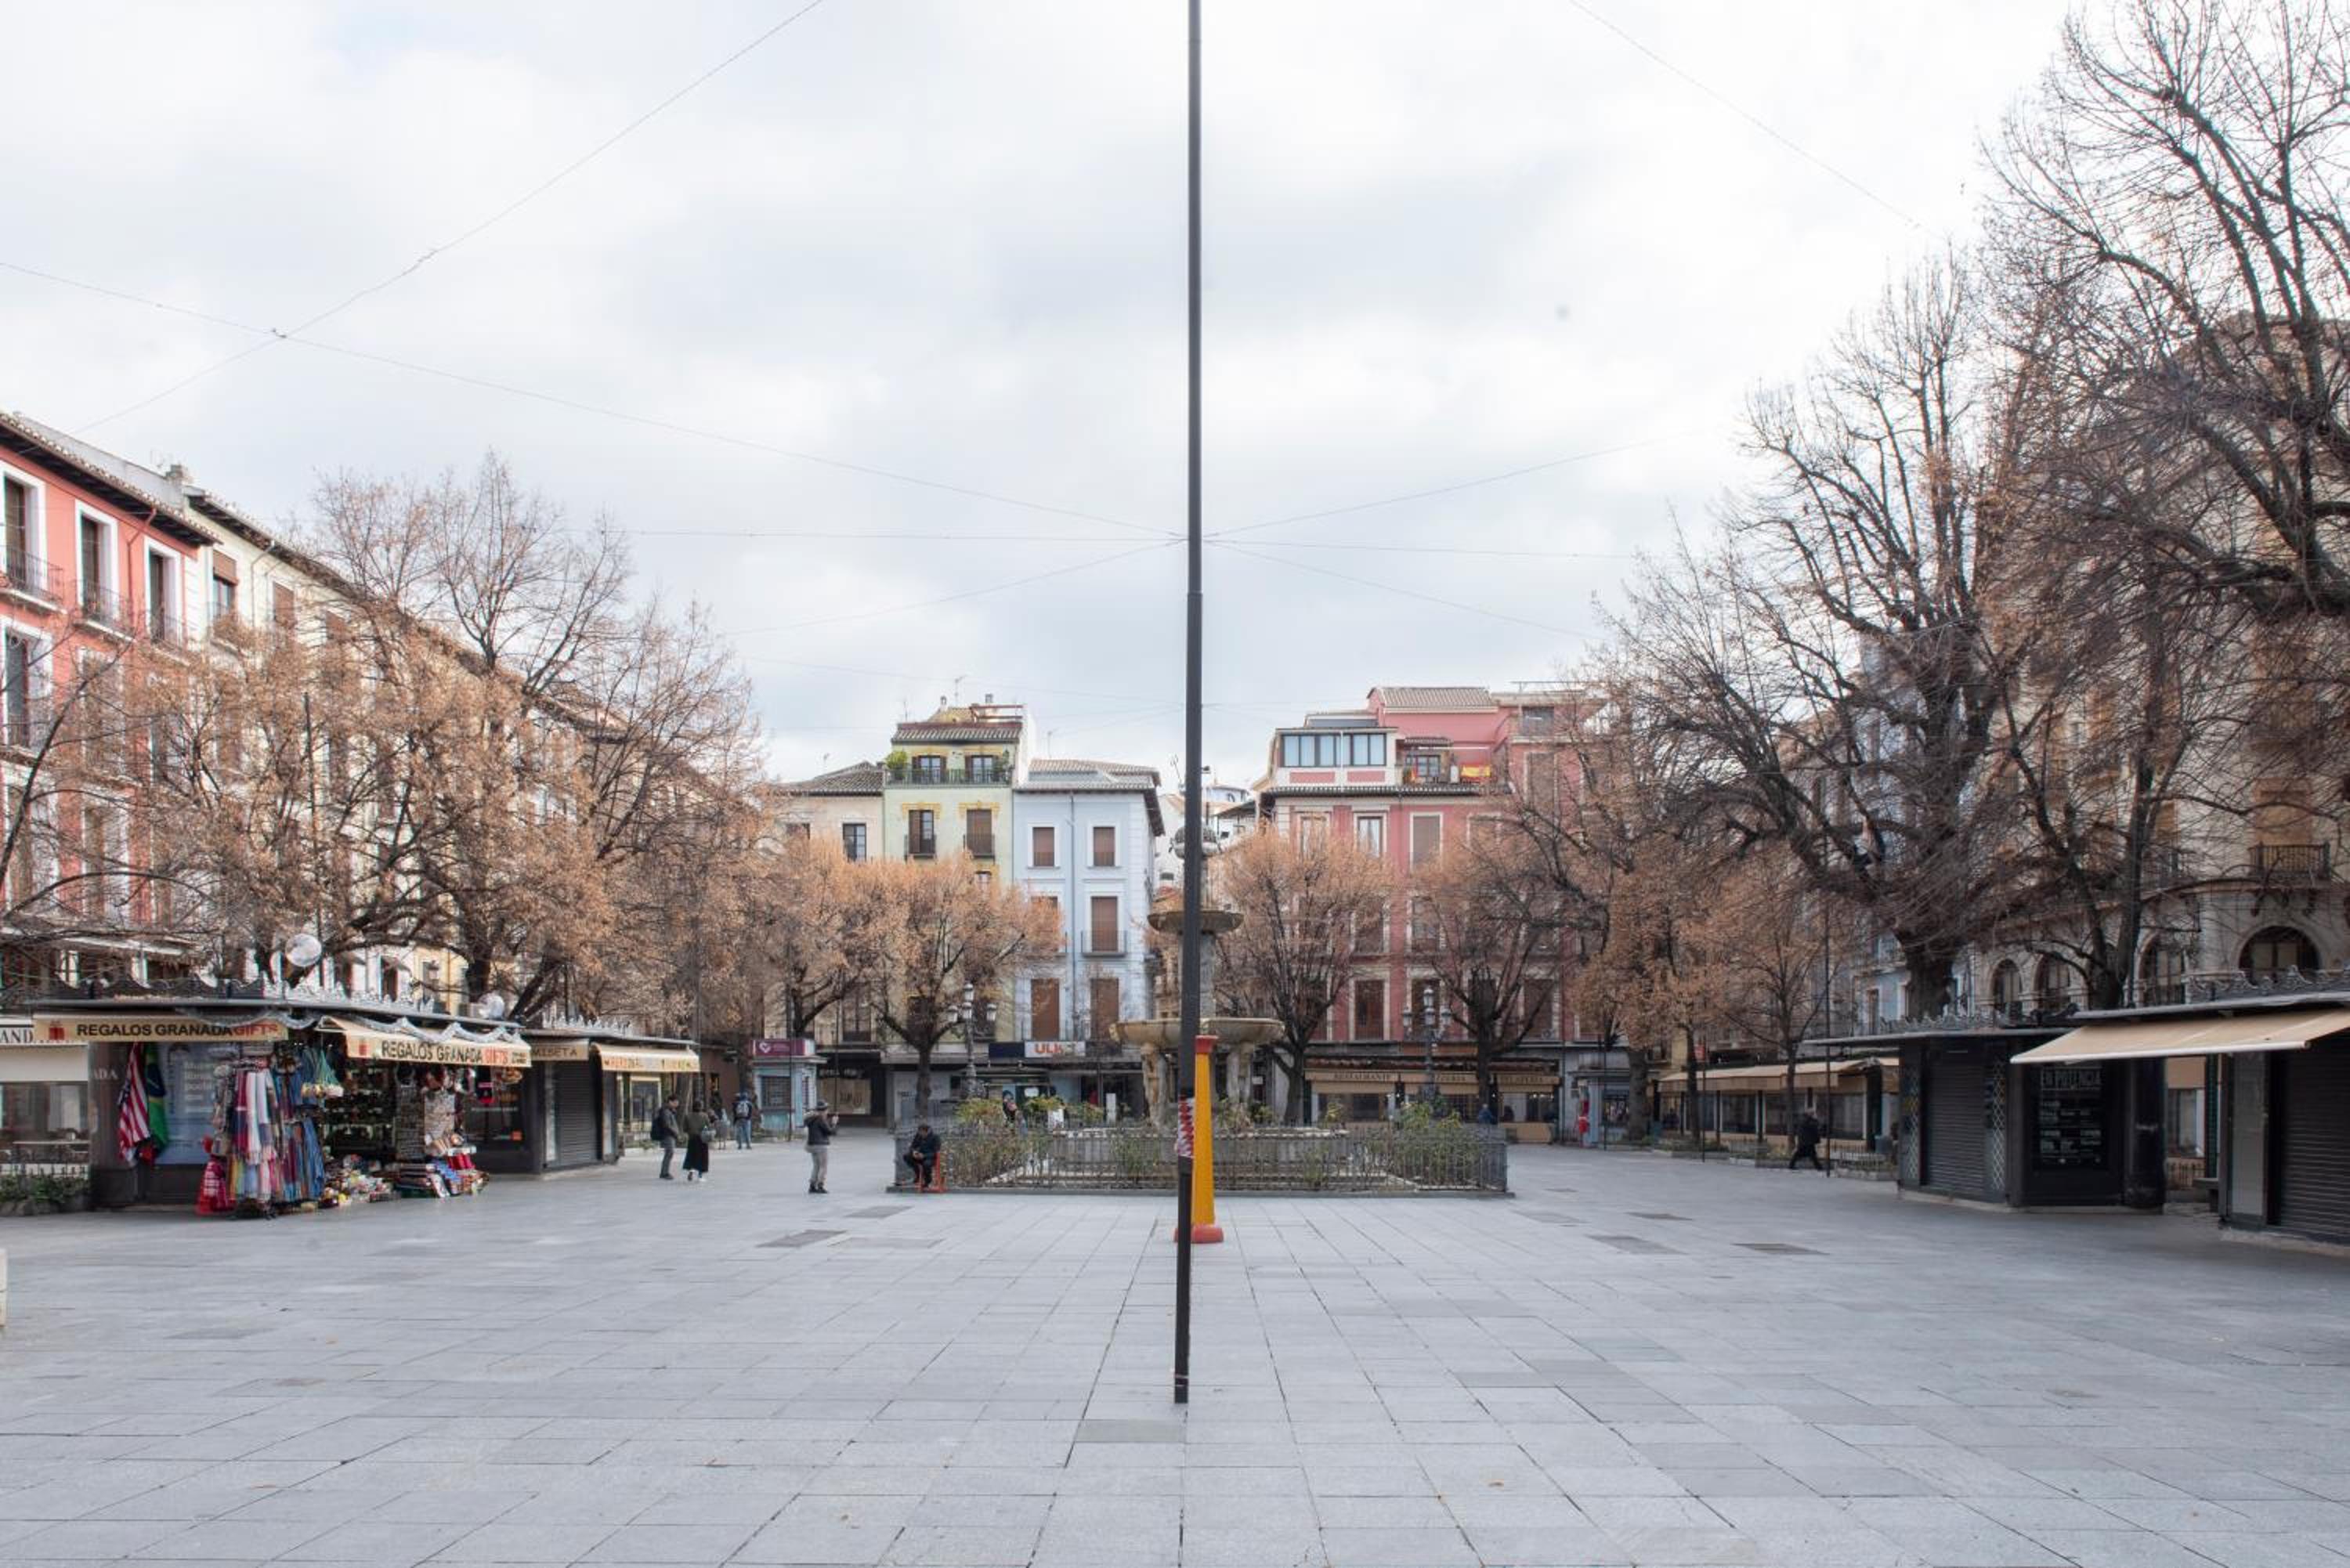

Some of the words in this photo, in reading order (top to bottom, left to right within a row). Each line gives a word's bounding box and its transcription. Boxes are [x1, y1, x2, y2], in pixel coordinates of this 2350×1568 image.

[78, 1024, 151, 1036] REGALOS
[155, 1024, 233, 1036] GRANADA
[235, 1022, 277, 1036] GIFTS
[381, 1040, 433, 1060] REGALOS
[436, 1046, 483, 1063] GRANADA
[484, 1046, 508, 1064] GIFTS
